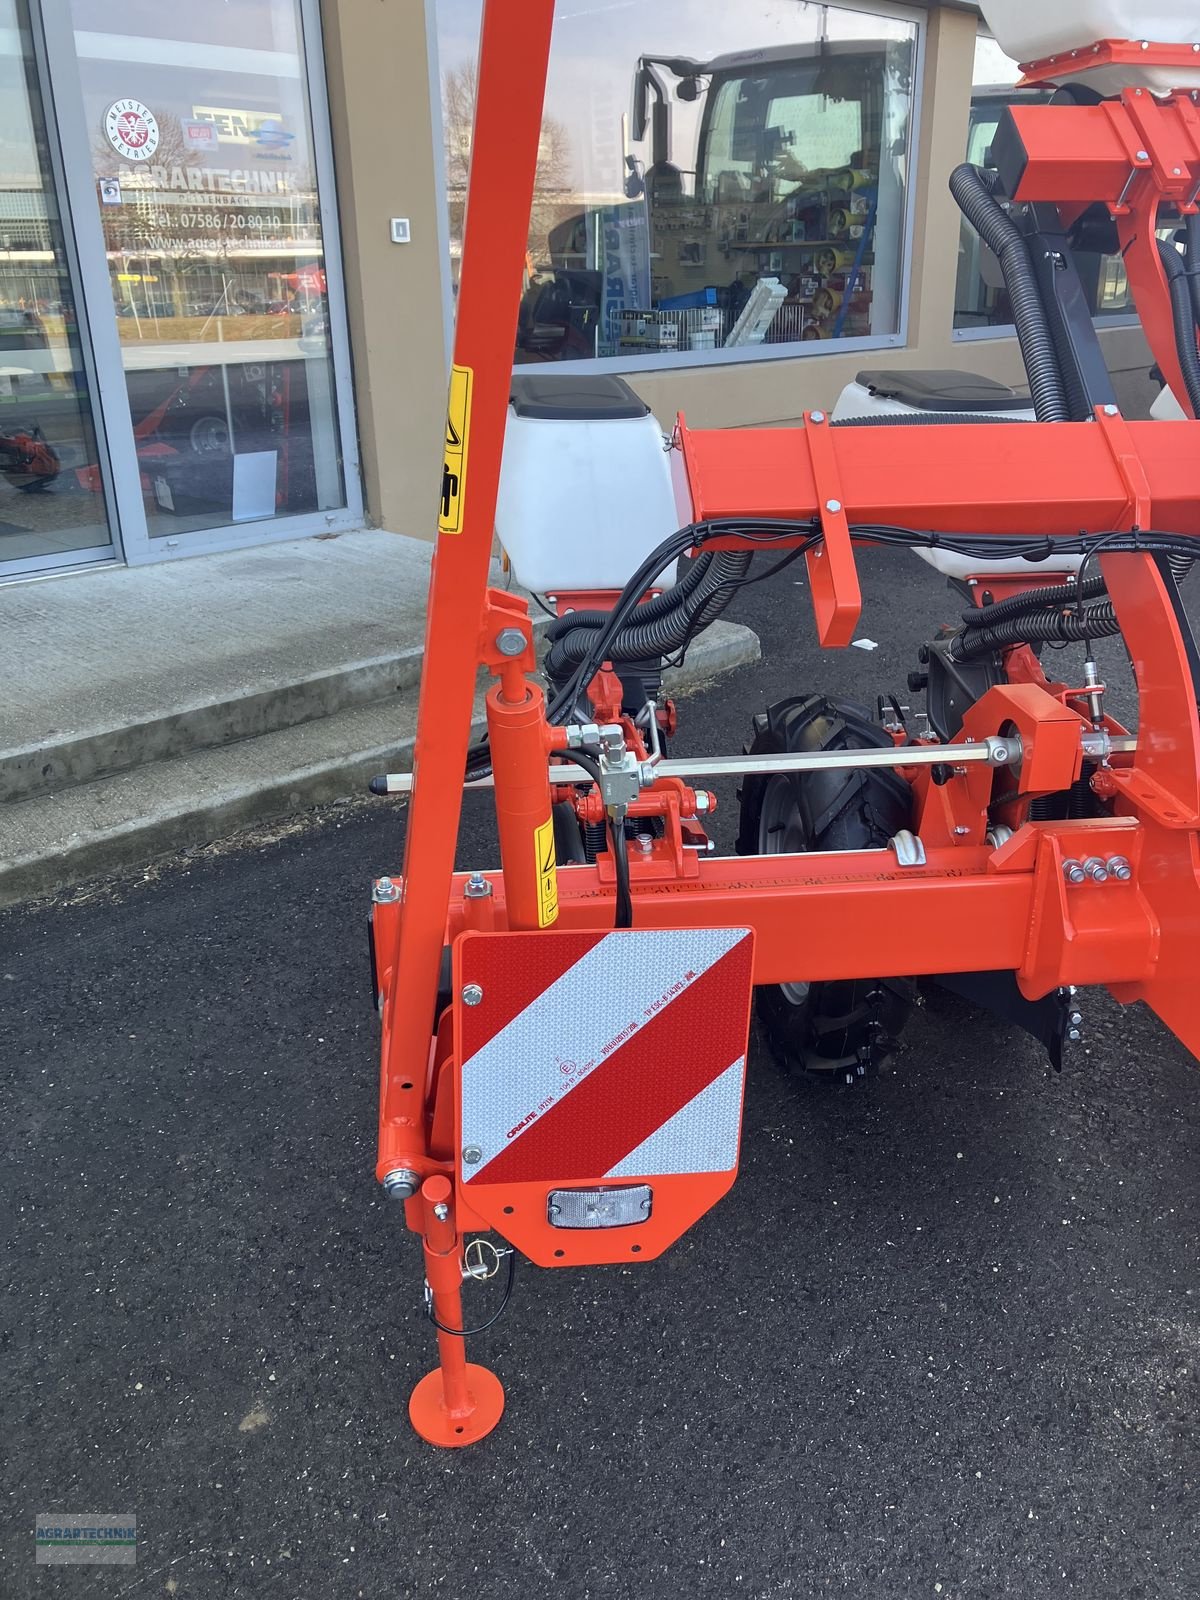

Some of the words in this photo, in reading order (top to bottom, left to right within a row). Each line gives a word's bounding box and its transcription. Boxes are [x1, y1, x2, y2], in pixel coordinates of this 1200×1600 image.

[109, 101, 154, 124] MEISTER
[119, 164, 298, 194] AGRARTECHNIK
[181, 213, 221, 228] 07586
[230, 214, 245, 228] 20
[507, 1111, 537, 1138] ORALITE
